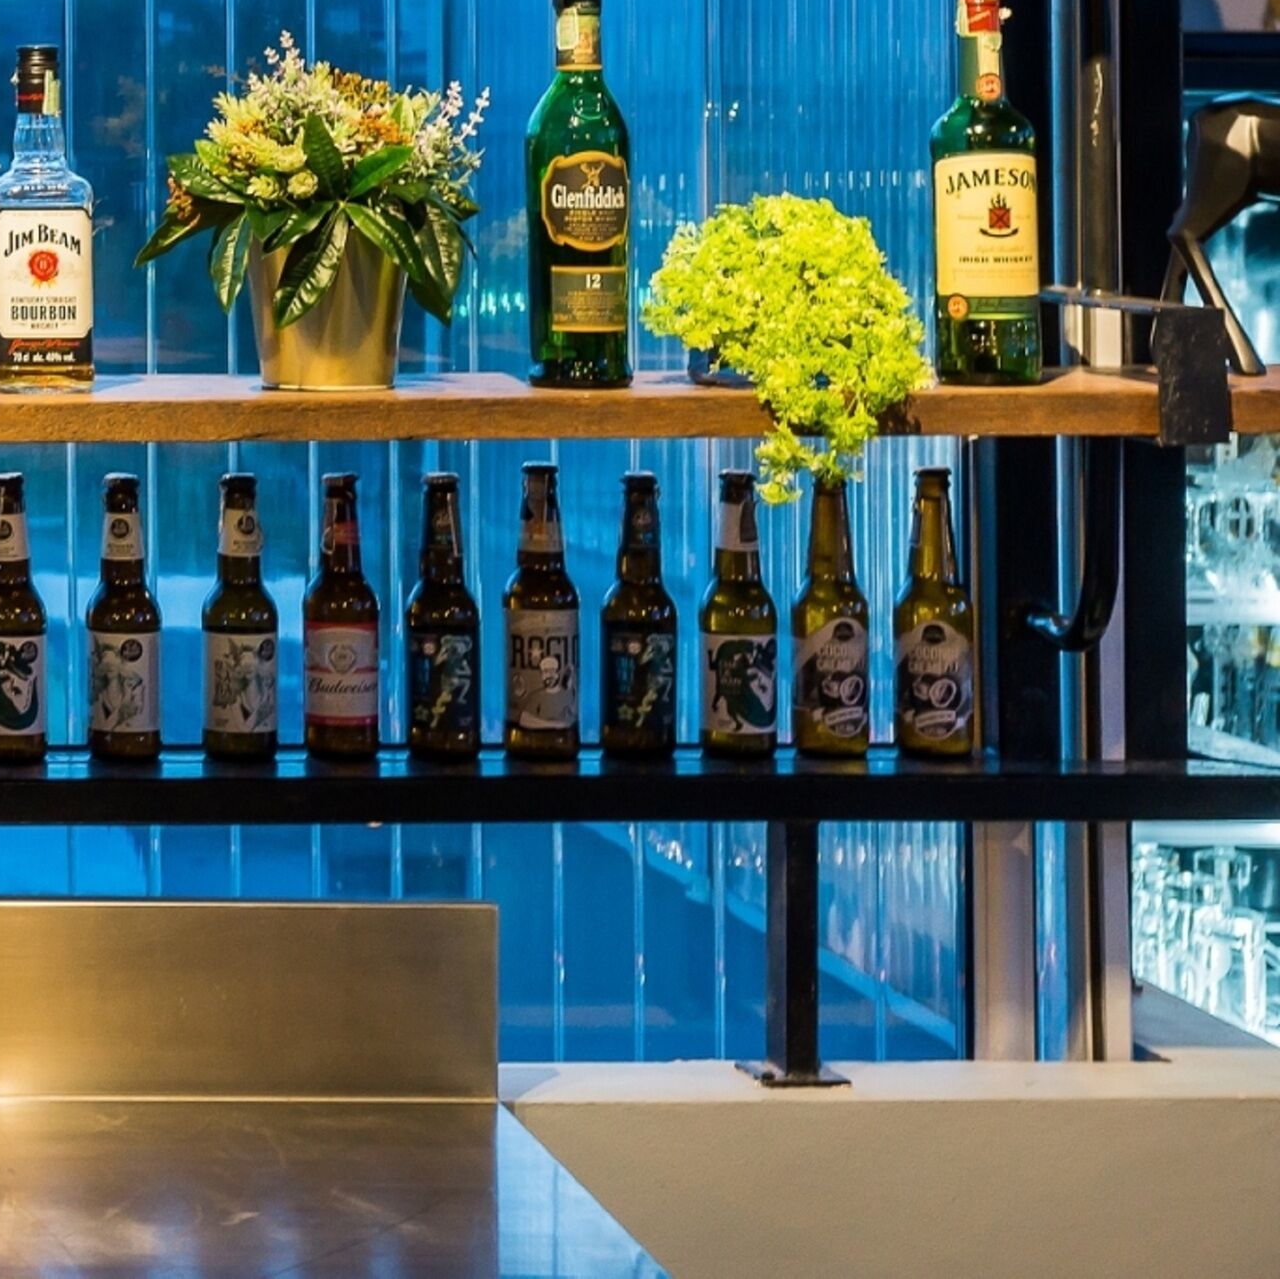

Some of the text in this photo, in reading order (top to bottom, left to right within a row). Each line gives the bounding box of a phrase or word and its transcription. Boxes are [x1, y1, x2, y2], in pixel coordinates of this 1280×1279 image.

[551, 183, 626, 209] Glenfiddich
[3, 223, 82, 258] JIM BEAM
[585, 273, 601, 289] 12
[11, 305, 77, 321] BOURBON
[307, 676, 377, 695] Budweiser
